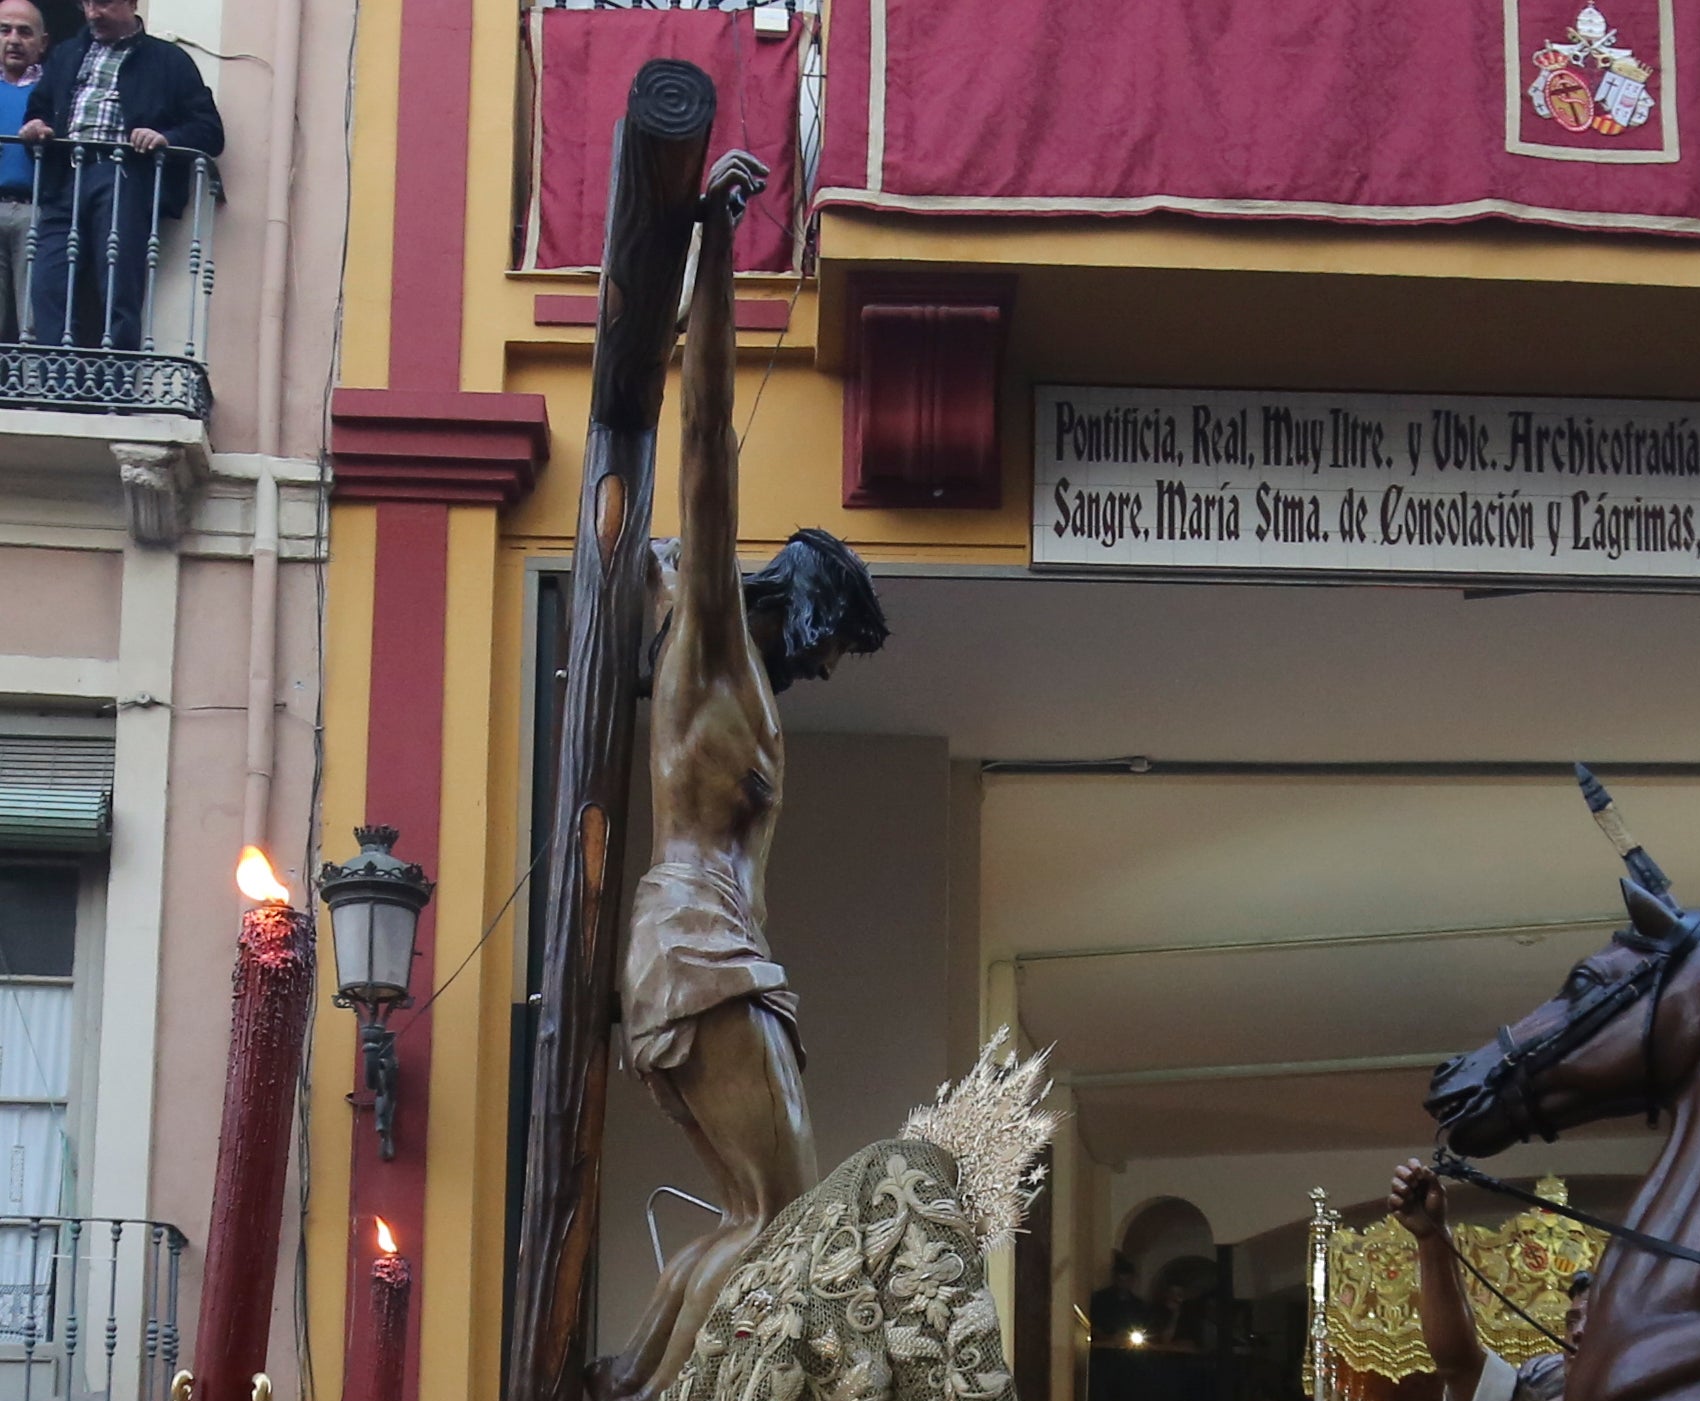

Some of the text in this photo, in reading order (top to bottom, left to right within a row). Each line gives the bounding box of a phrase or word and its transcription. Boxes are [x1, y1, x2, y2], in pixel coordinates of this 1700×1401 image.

[1055, 401, 1183, 467] Pontificia,
[1192, 405, 1254, 470] Real,
[1262, 406, 1324, 473] Muy
[1408, 422, 1422, 475] y
[1505, 411, 1700, 476] Archicofradía
[1054, 477, 1149, 548] Sangre,
[1156, 480, 1239, 541] María
[1256, 481, 1328, 543] Stma.
[1340, 488, 1368, 543] de
[1381, 484, 1534, 549] Consolación
[1548, 501, 1561, 556] y
